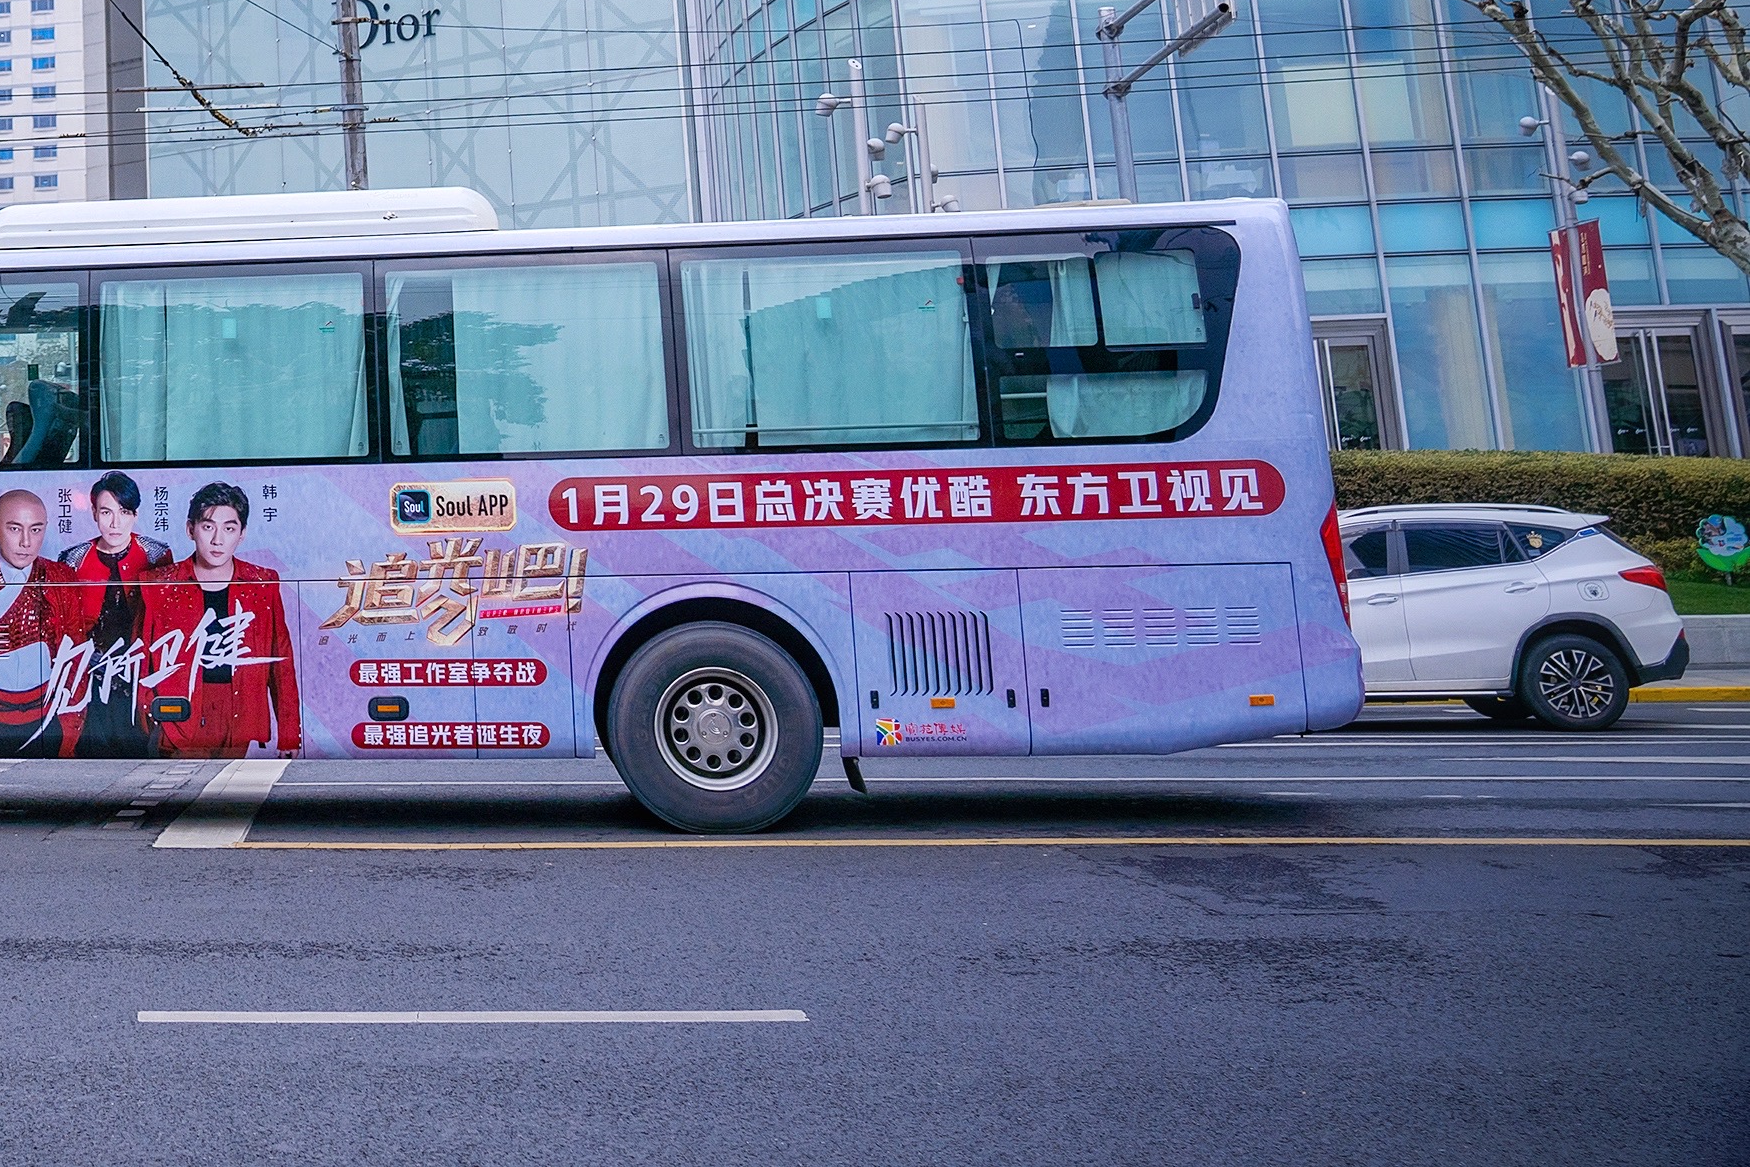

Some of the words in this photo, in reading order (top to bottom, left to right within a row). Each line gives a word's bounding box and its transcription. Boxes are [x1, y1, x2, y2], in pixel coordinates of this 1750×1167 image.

[57, 488, 73, 534] 张卫健
[154, 486, 169, 533] 杨宗纬
[262, 484, 278, 523] 韩宇
[403, 500, 425, 514] Soul
[435, 495, 473, 517] Soul
[477, 494, 509, 516] APP
[560, 474, 992, 525] 1月29日总决赛优酷
[1016, 467, 1264, 516] 东方卫视见
[358, 661, 537, 684] 最强工作室争夺战
[363, 724, 543, 746] 最强追光者诞生夜
